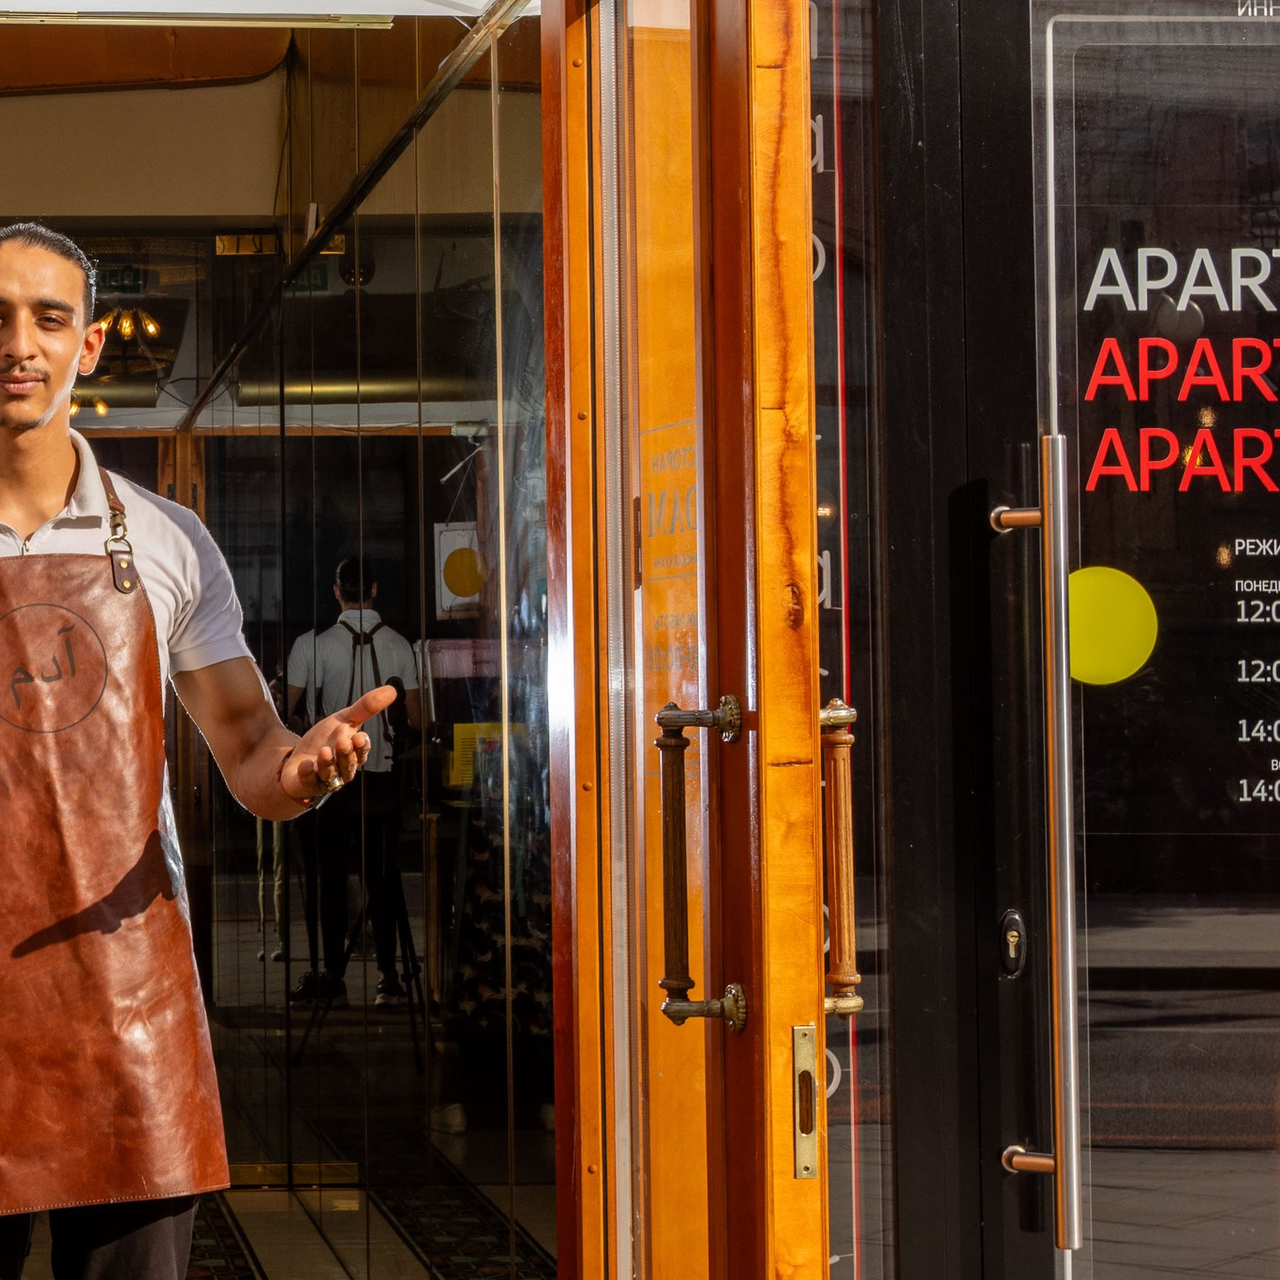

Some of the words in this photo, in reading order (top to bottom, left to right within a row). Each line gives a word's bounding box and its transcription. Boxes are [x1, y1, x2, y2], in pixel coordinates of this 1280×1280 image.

[1084, 248, 1280, 311] APAR
[1085, 338, 1280, 402] APAR
[1086, 428, 1280, 492] APAR
[1235, 580, 1280, 594] ПОНЕД
[10, 622, 76, 710] آدم
